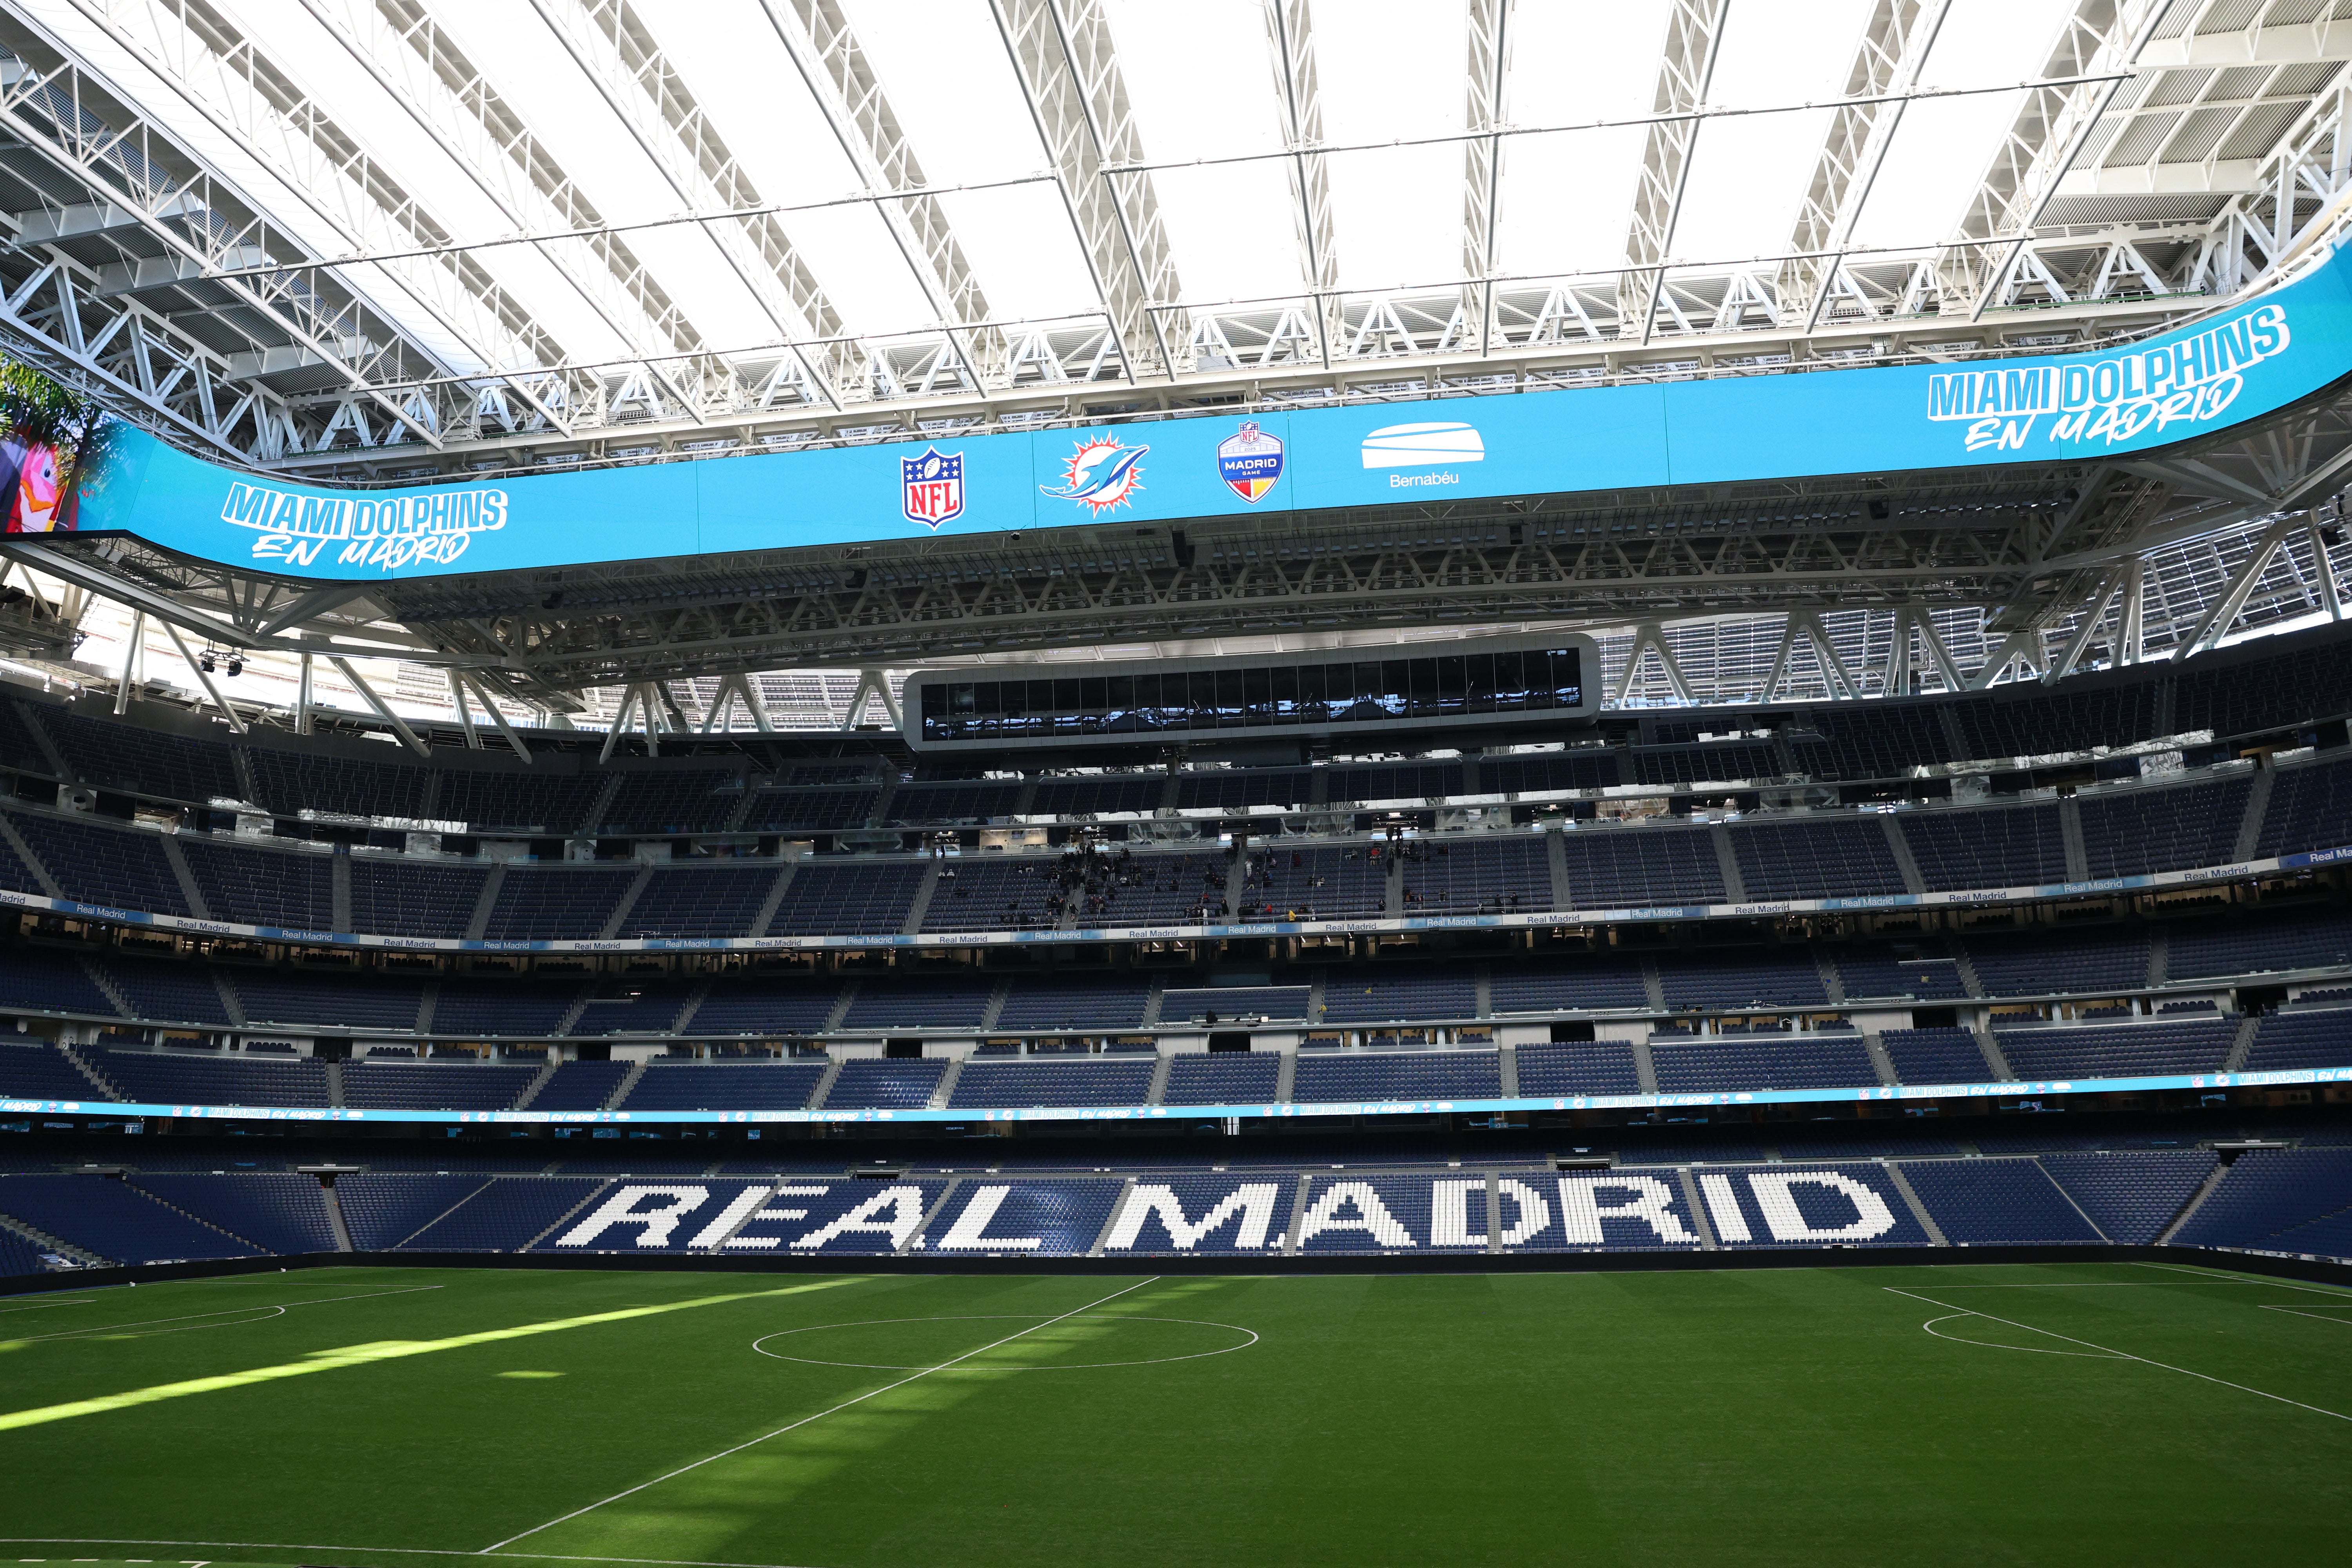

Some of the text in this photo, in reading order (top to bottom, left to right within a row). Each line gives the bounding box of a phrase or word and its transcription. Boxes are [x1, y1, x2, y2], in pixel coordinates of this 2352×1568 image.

[1927, 304, 2291, 421] MIAMI DOLPHINS
[1965, 372, 2243, 452] EN MADRID
[1242, 431, 1257, 442] NFL
[1225, 458, 1277, 470] MADRID
[1390, 471, 1459, 488] Bernabéu
[909, 482, 957, 517] NFL
[221, 482, 508, 540] MIAMI DOLPHINS
[252, 532, 470, 572] EN MADRID
[2310, 851, 2334, 862] Real
[2185, 866, 2248, 881] Real Madrid
[2064, 880, 2123, 892] Real Madrid
[1864, 897, 1894, 906] Madrid
[1973, 892, 2006, 900] Madrid
[77, 904, 125, 919] Real Madrid
[177, 920, 230, 933] Real Madrid
[303, 932, 332, 941] Madrid
[2238, 1074, 2269, 1085] MIAMI
[2269, 1071, 2315, 1084] DOLPHINS
[2317, 1069, 2336, 1081] EN
[1899, 1084, 2029, 1098] MIAMI DOLPHINS EN MADRID
[3, 1102, 42, 1112] MADRID
[1592, 1095, 1713, 1108] MIAMI DOLPHINS EN MADRID
[208, 1107, 326, 1120] MIAMI DOLPHINS EN MADRID
[1020, 1109, 1131, 1120] MIAMI DOLPHINS EN MADRID
[1299, 1103, 1416, 1115] MIAMI DOLPHINS EN MADRID
[494, 1112, 597, 1122] MIAMI DOLPHINS EN MADRID
[752, 1112, 859, 1122] MIAMI DOLPHINS EN MADRID
[555, 1171, 1896, 1250] REAL MADRID
